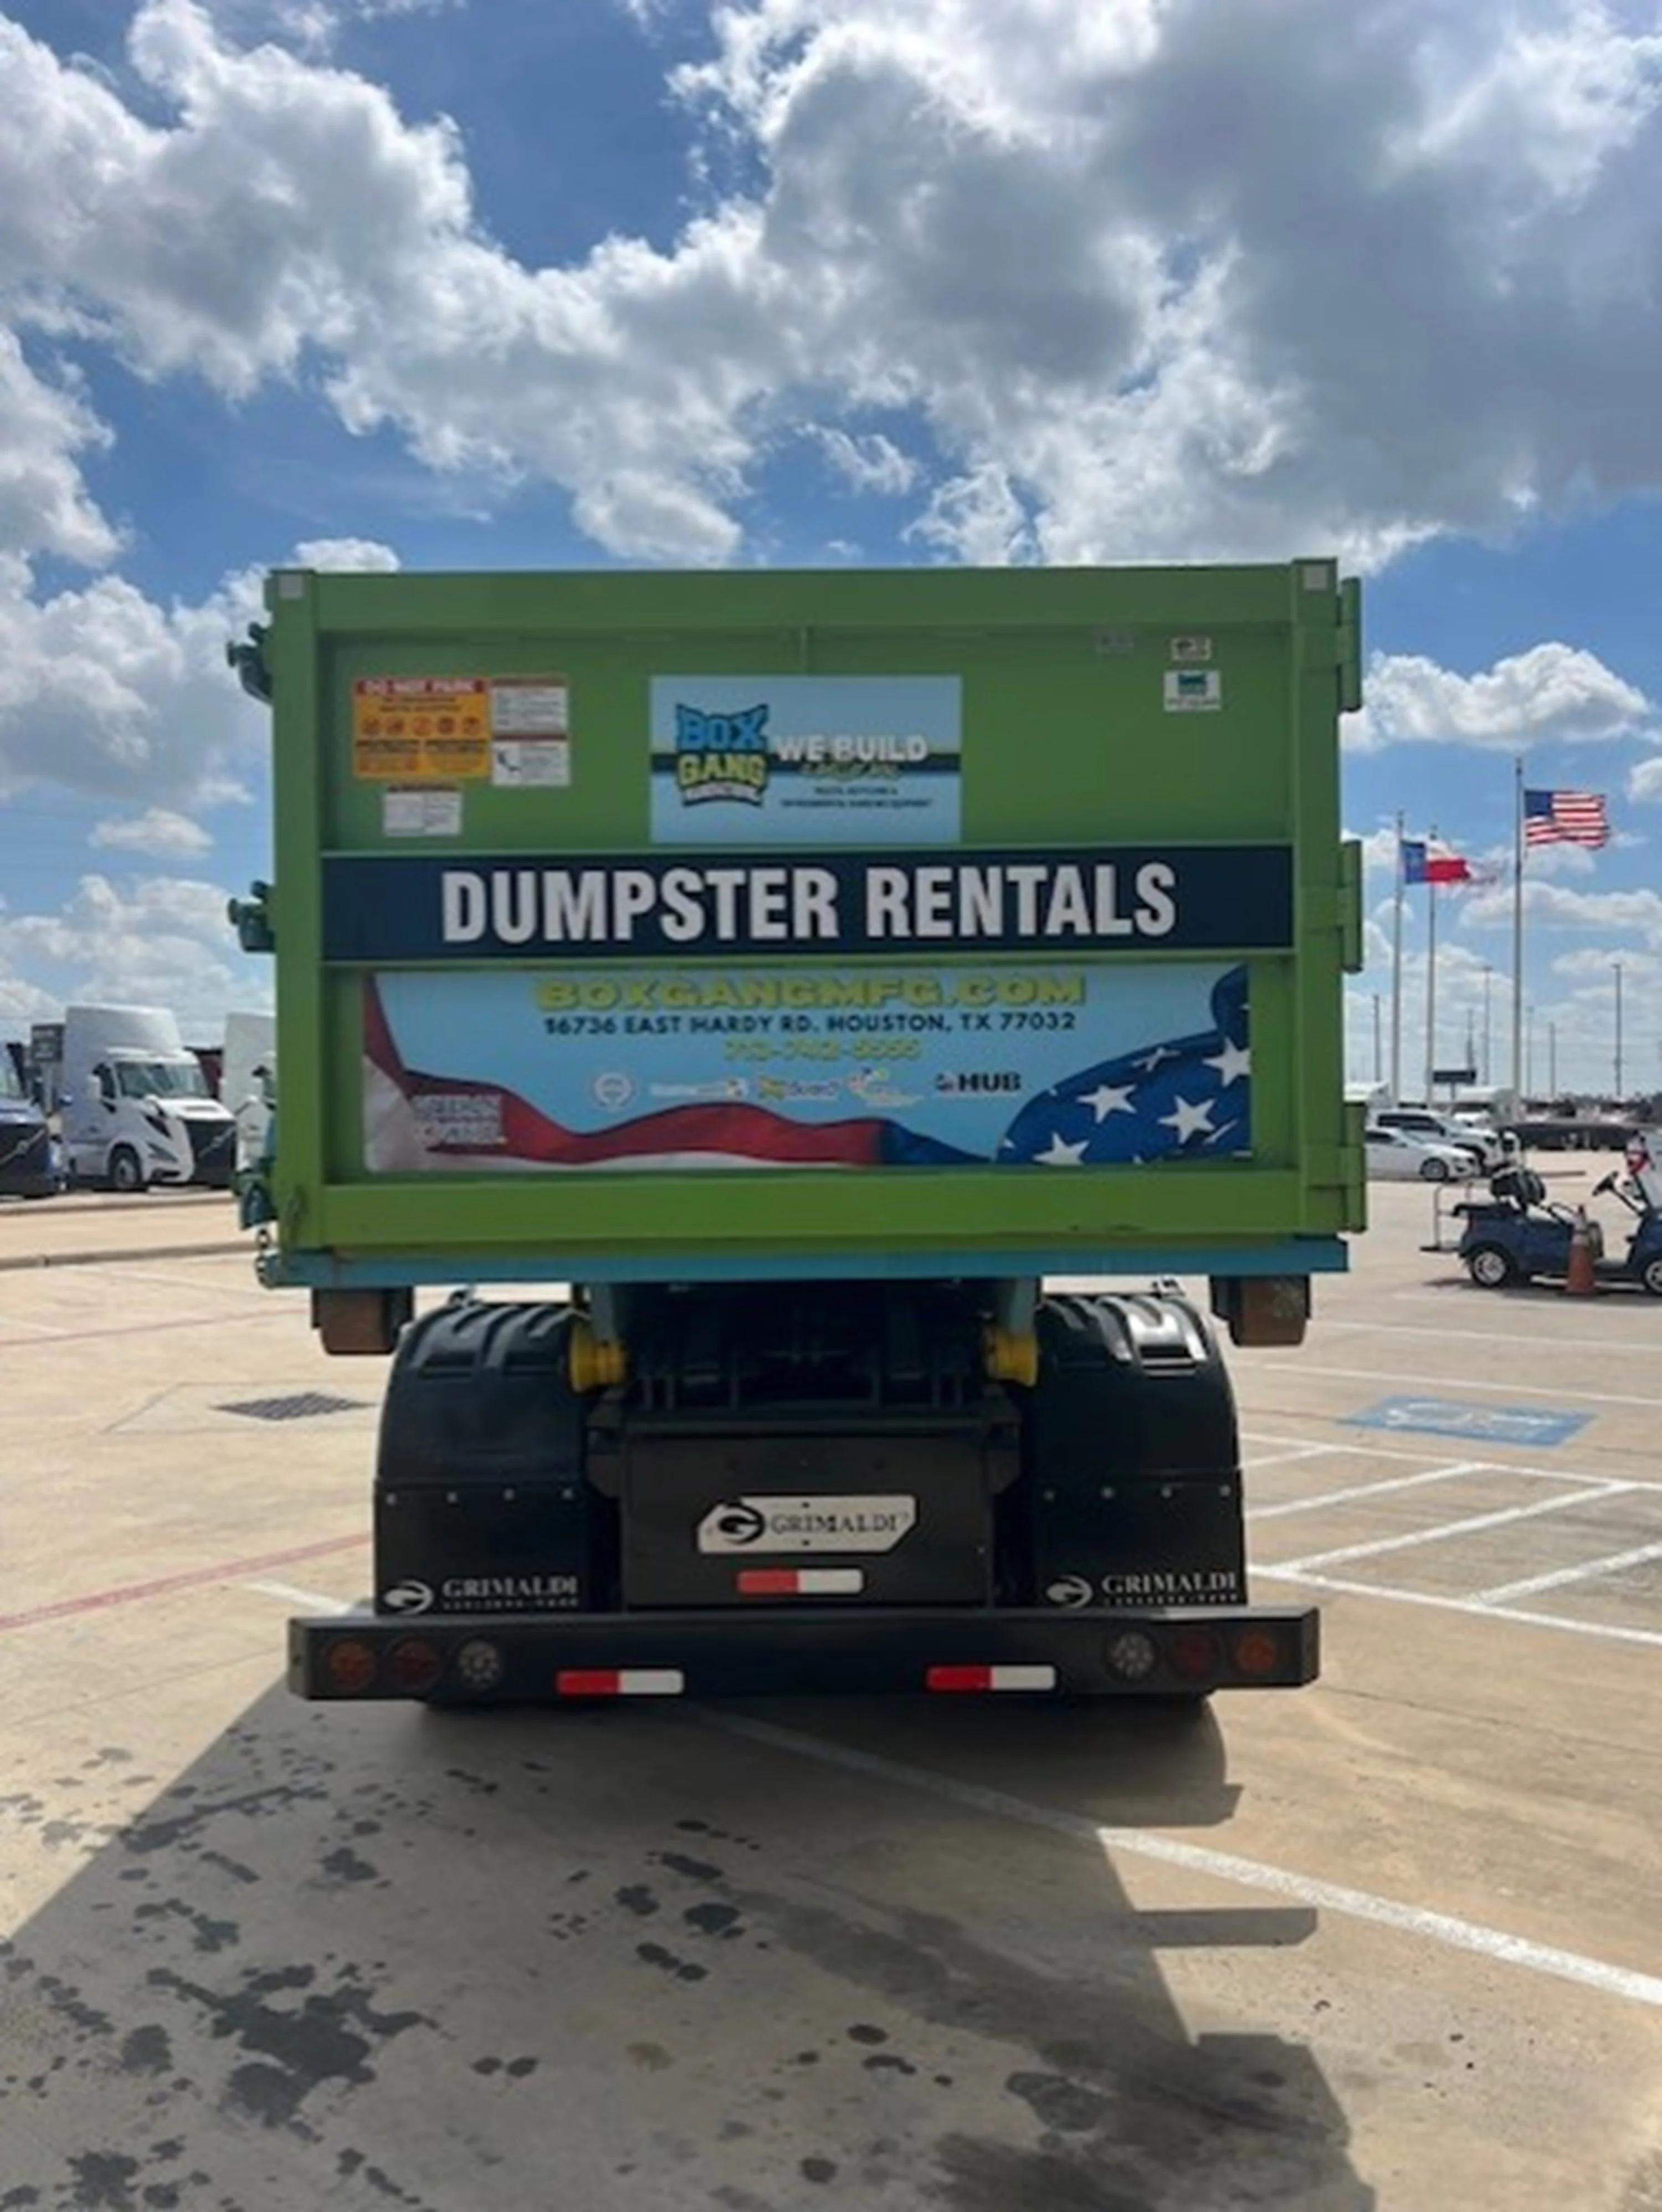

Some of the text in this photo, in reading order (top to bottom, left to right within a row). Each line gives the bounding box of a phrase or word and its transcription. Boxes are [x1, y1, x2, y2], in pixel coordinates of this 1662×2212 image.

[676, 704, 769, 750] BOX
[775, 735, 929, 762] WE BUILD
[678, 754, 768, 785] GANG
[443, 863, 1176, 943] DUMPSTER RENTALS
[540, 975, 1084, 1010] BOXGANGMFG.COM
[544, 1010, 1076, 1035] 16736 EAST HARDY RD. HOUSTON, TX 77032
[957, 1072, 1022, 1092] HUB
[770, 1513, 898, 1535] GRIMALDI
[444, 1575, 578, 1598] GRIMALDI
[1101, 1571, 1238, 1594] GRIMALDI
